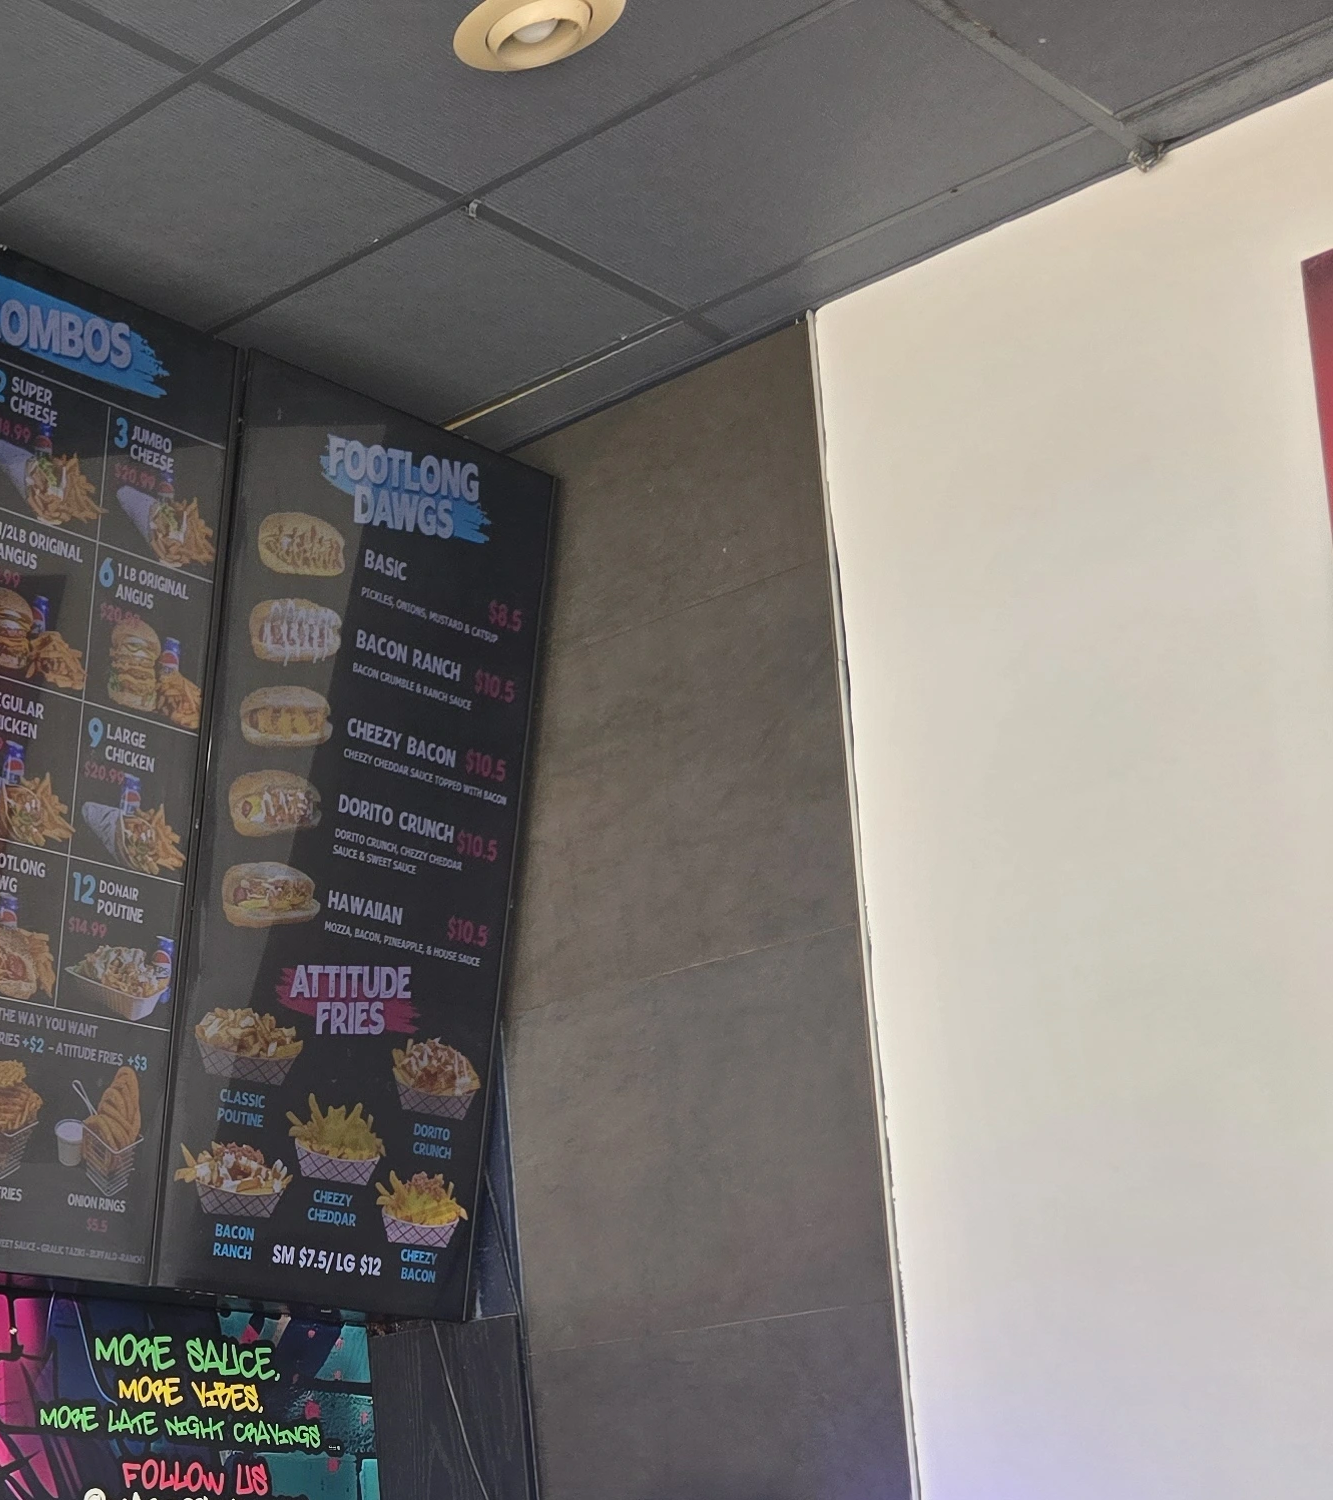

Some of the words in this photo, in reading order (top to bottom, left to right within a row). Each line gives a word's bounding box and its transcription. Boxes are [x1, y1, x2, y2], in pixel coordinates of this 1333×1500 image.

[327, 433, 480, 502] FOOTLONG
[353, 485, 455, 540] DAWGS
[364, 548, 408, 582] BASIC
[356, 628, 408, 664] BACON
[412, 649, 461, 682] RANCH
[328, 889, 404, 926] HAWAIIAN
[289, 964, 412, 1000] ATTITUDE
[315, 1001, 385, 1035] FRIES
[67, 1192, 97, 1209] ONION
[98, 1197, 126, 1213] RINGS
[272, 1244, 295, 1266] SM
[336, 1252, 356, 1273] LG
[359, 1254, 382, 1277] $12
[95, 1334, 175, 1372] MORE
[118, 1375, 183, 1408] MORE
[40, 1405, 99, 1432] MORE
[108, 1409, 158, 1437] LATE
[164, 1415, 225, 1441] NIGHT
[233, 1422, 321, 1449] CRAVINGS
[122, 1459, 225, 1495] FOLLOW
[235, 1463, 268, 1497] US
